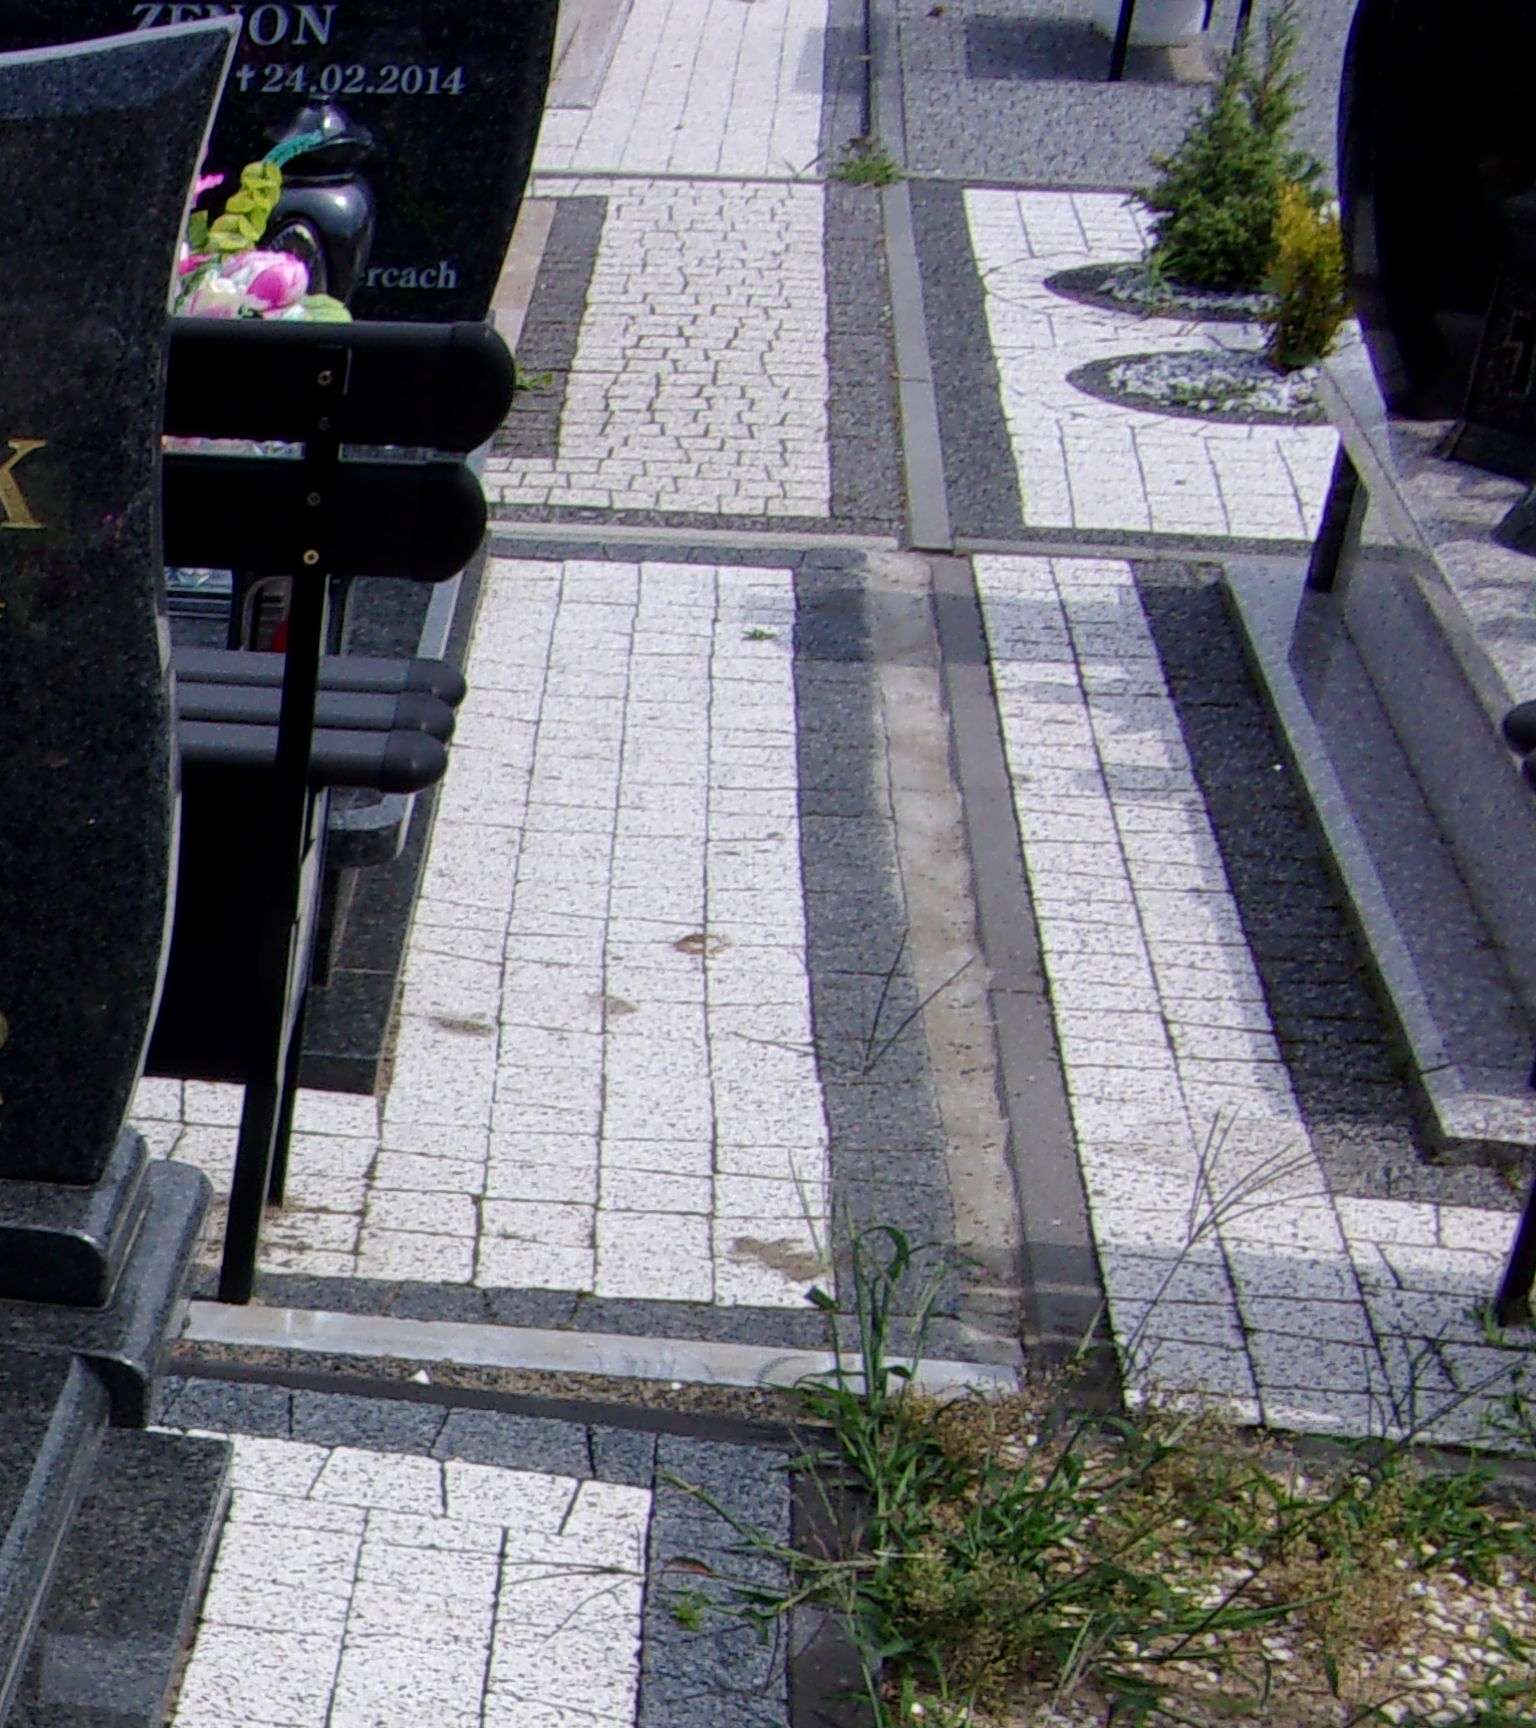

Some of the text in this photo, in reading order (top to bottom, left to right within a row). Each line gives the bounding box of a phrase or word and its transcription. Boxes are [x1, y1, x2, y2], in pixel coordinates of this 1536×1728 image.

[131, 3, 336, 47] ZEON
[262, 63, 465, 95] 24.02.2014
[358, 260, 458, 289] rcach
